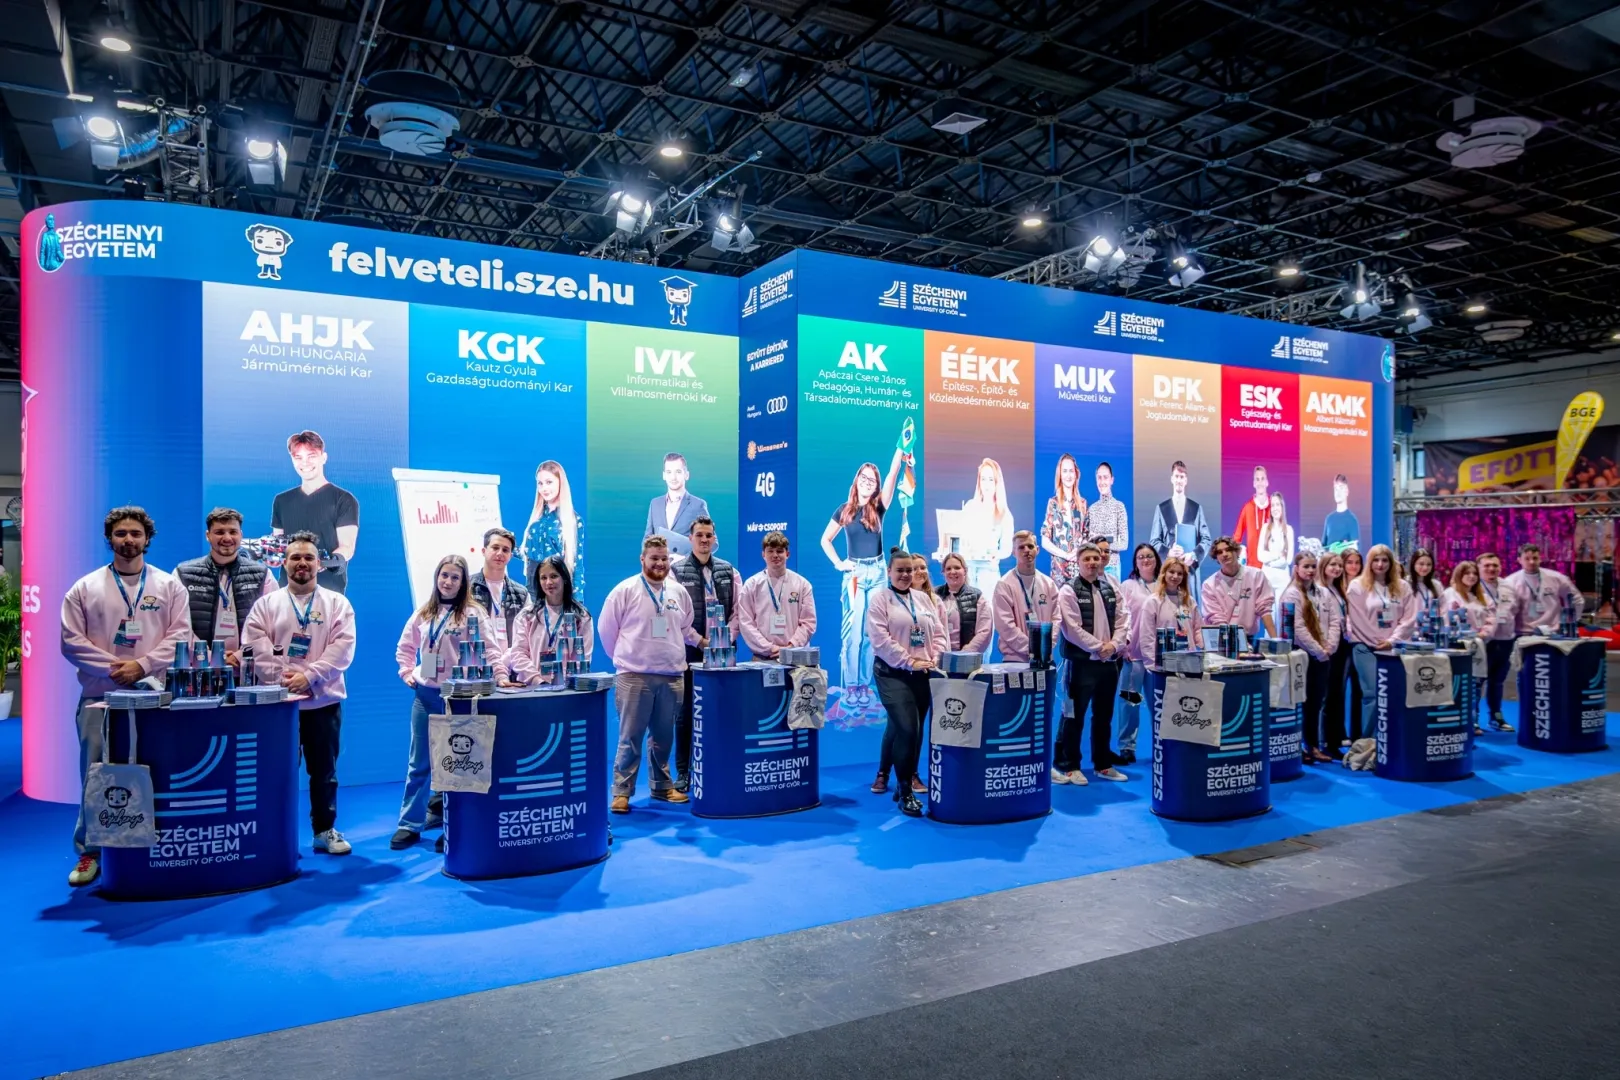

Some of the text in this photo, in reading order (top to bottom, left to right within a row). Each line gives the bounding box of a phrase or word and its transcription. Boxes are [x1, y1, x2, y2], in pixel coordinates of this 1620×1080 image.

[56, 221, 162, 243] SZÉCHENYI
[63, 242, 155, 259] EGYETEM
[328, 242, 634, 306] felveteli.sze.hu
[760, 269, 793, 293] SZÉCHENYI
[760, 282, 787, 304] EGYETEM
[912, 283, 967, 301] SZÉCHENYI
[912, 293, 959, 309] EGYETEM
[1120, 313, 1164, 328] SZÉCHENYI
[1120, 322, 1158, 335] EGYETEM
[239, 309, 375, 351] AHJK
[458, 329, 546, 365] KGK
[1292, 337, 1329, 350] SZÉCHENYI
[1292, 346, 1324, 357] EGYETEM
[248, 344, 367, 363] AUDI HUNGARIA
[634, 346, 697, 378] IVK
[837, 340, 889, 372] AK
[350, 366, 373, 378] Kar
[466, 361, 537, 377] Kautz Gyula
[940, 344, 1021, 385] ÉÉKK
[426, 372, 573, 393] Gazdaságtudományi Kar
[627, 374, 704, 390] Informatikai és
[818, 369, 907, 386] Apáczai Csere János
[1054, 363, 1117, 395] MUK
[610, 386, 718, 404] Villamosmérnöki Kar
[812, 380, 912, 398] Pedagógia, Humán- és
[1008, 387, 1018, 397] és
[1153, 374, 1203, 402] DFK
[1240, 383, 1283, 410] ESK
[804, 392, 919, 411] Társadalomtudományi Kar
[929, 392, 1030, 410] Közlekedésmérnöki Kar
[1098, 394, 1112, 404] Kar
[1305, 391, 1367, 418] AKMK
[1197, 415, 1210, 423] Kar
[1570, 408, 1596, 417] BGE
[1532, 653, 1550, 739] SZÉCHENYI
[745, 756, 809, 773] SZÉCHENYI
[985, 762, 1044, 779] SZÉCHENYI
[1207, 761, 1262, 778] SZÉCHENYI
[745, 769, 800, 785] EGYETEM
[985, 775, 1037, 791] EGYETEM
[1207, 774, 1256, 790] EGYETEM
[745, 784, 777, 792] UNIVERSITY
[985, 790, 1016, 798] UNIVERSITY
[1207, 789, 1237, 797] UNIVERSITY
[499, 802, 587, 824] SZÉCHENYI
[156, 821, 257, 843] SZÉCHENYI
[499, 818, 574, 839] EGYETEM
[150, 838, 240, 858] EGYETEM
[499, 836, 542, 847] UNIVERSITY
[543, 834, 553, 843] OF
[150, 858, 199, 868] UNIVERSITY
[201, 855, 213, 865] OF
